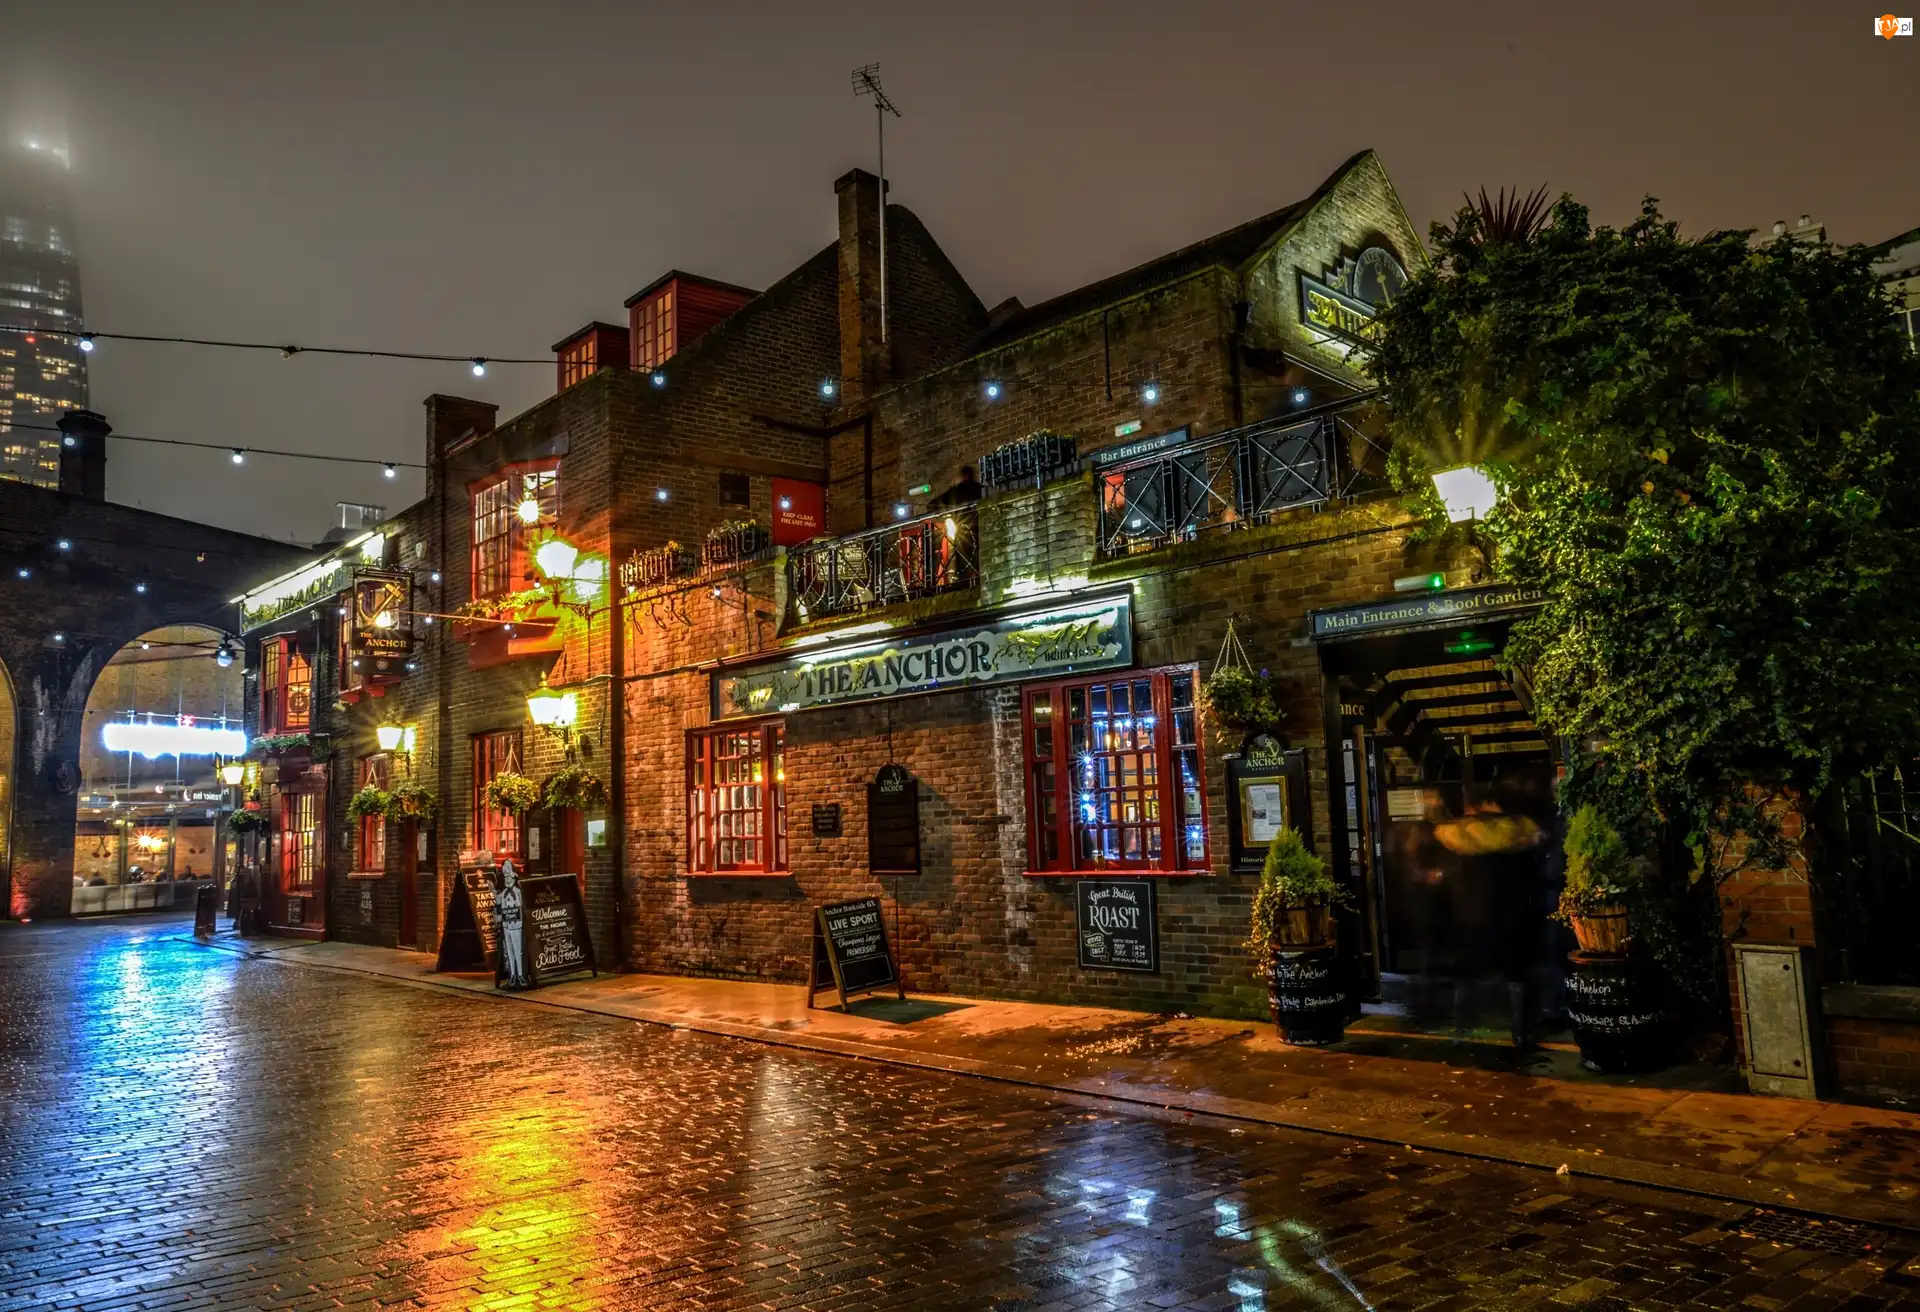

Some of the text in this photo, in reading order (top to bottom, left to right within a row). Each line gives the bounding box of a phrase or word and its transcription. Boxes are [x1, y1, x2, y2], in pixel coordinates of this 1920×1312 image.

[1100, 439, 1166, 463] Bar Entrance
[1324, 588, 1542, 629] Main Entrance & Roof Garden
[366, 639, 407, 648] ANCHOR
[799, 640, 992, 699] THE ANCHOR
[1252, 750, 1267, 759] THE
[1245, 757, 1285, 768] ANCHOR
[475, 892, 495, 901] TAKE
[1088, 886, 1138, 905] Great British
[532, 906, 568, 920] Welcome
[843, 902, 866, 913] Bankside
[828, 918, 848, 931] LIVE
[850, 912, 877, 927] SPORT
[1088, 905, 1140, 935] ROAST
[558, 946, 585, 964] Food
[846, 945, 877, 957] PREMIERSHIP
[1300, 968, 1328, 979] Anchor
[1579, 979, 1611, 995] Anchor
